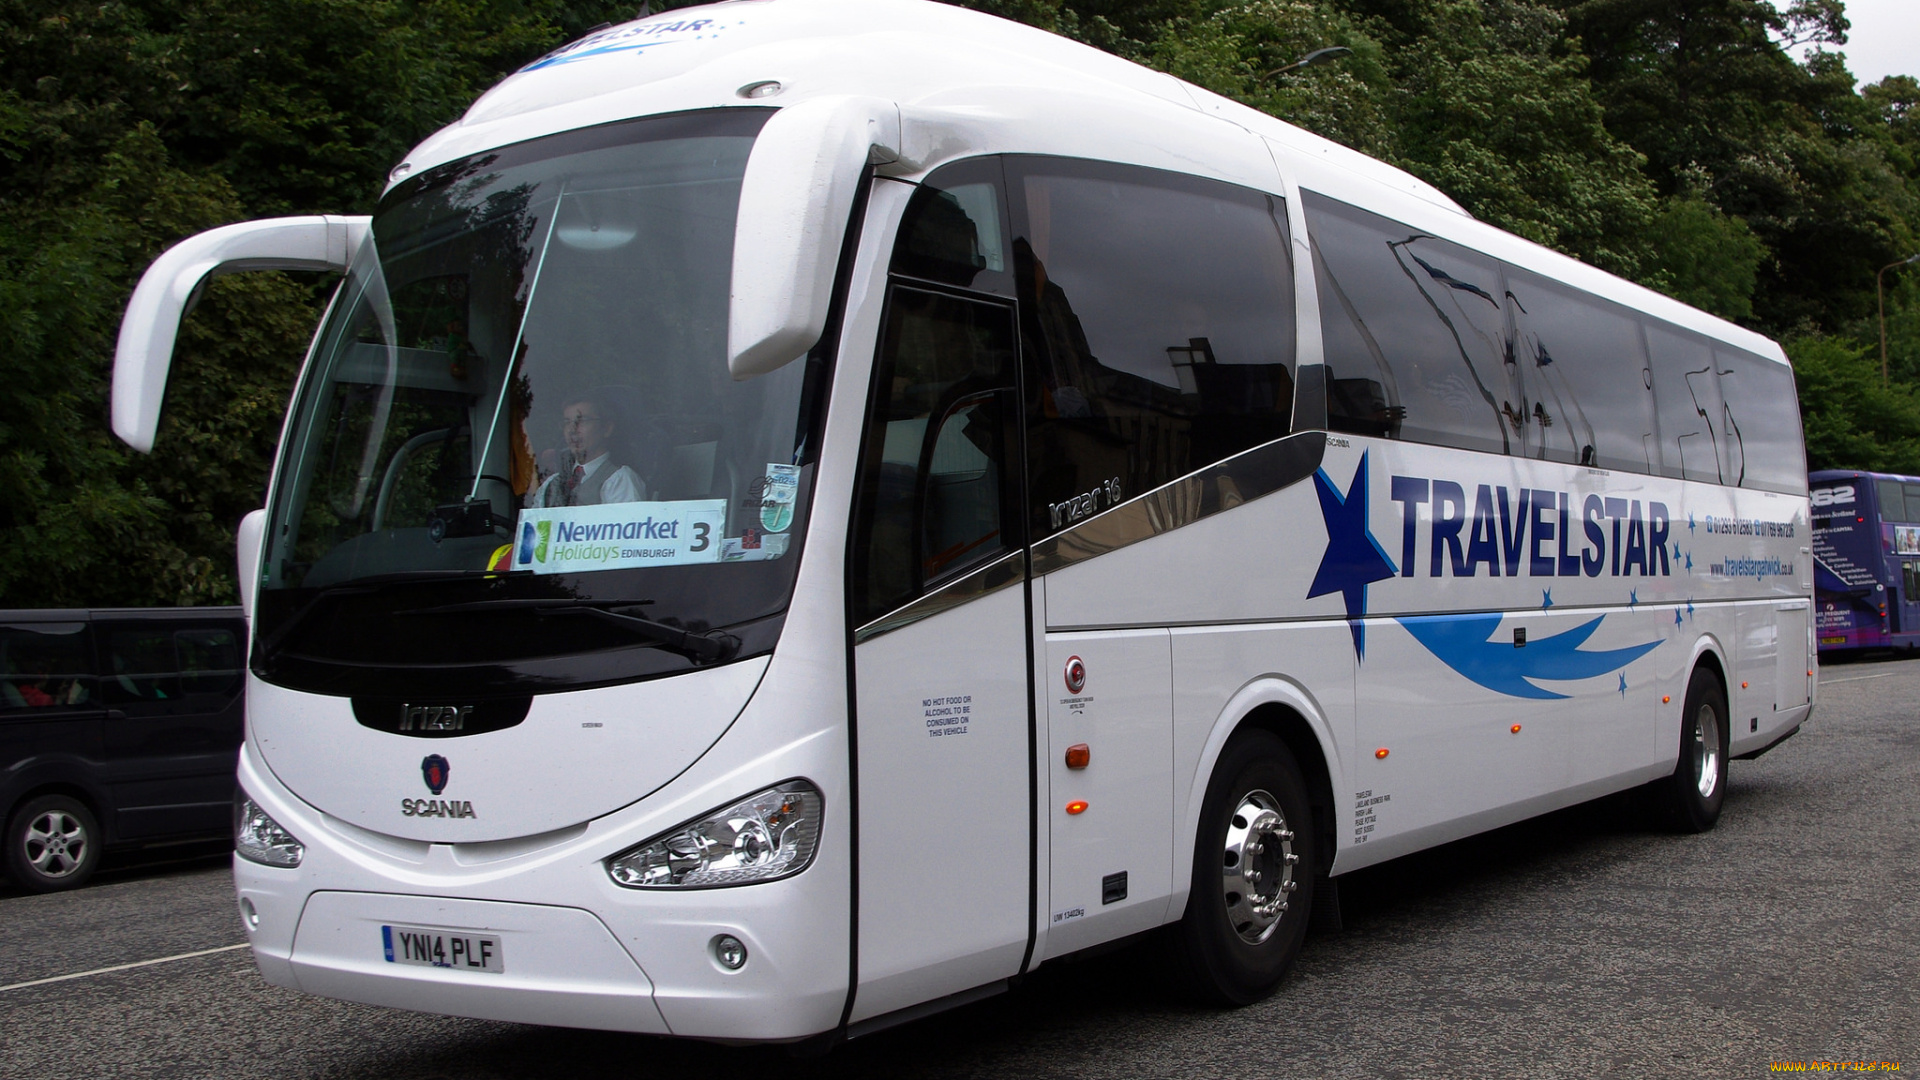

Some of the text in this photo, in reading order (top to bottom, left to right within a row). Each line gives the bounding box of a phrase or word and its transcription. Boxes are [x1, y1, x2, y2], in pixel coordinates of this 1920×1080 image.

[1326, 436, 1350, 448] SCANIA
[1104, 476, 1121, 506] i6
[1810, 485, 1856, 507] 62
[556, 516, 679, 543] Newmarket
[690, 522, 711, 552] 3
[1390, 474, 1671, 578] TRAVELSTAR
[552, 545, 676, 563] Holidays EDINBURGH
[1709, 555, 1794, 582] www.travelstargatwick.co.uk
[922, 695, 972, 707] NO HOT FOOD OR
[924, 705, 971, 717] ALCOHOL TO BE
[400, 702, 474, 731] Irizar
[926, 716, 969, 727] CONSUMED ON
[929, 726, 968, 738] THIS VEHICLE
[401, 797, 477, 819] SCANIA
[399, 931, 493, 968] YN14 PLF
